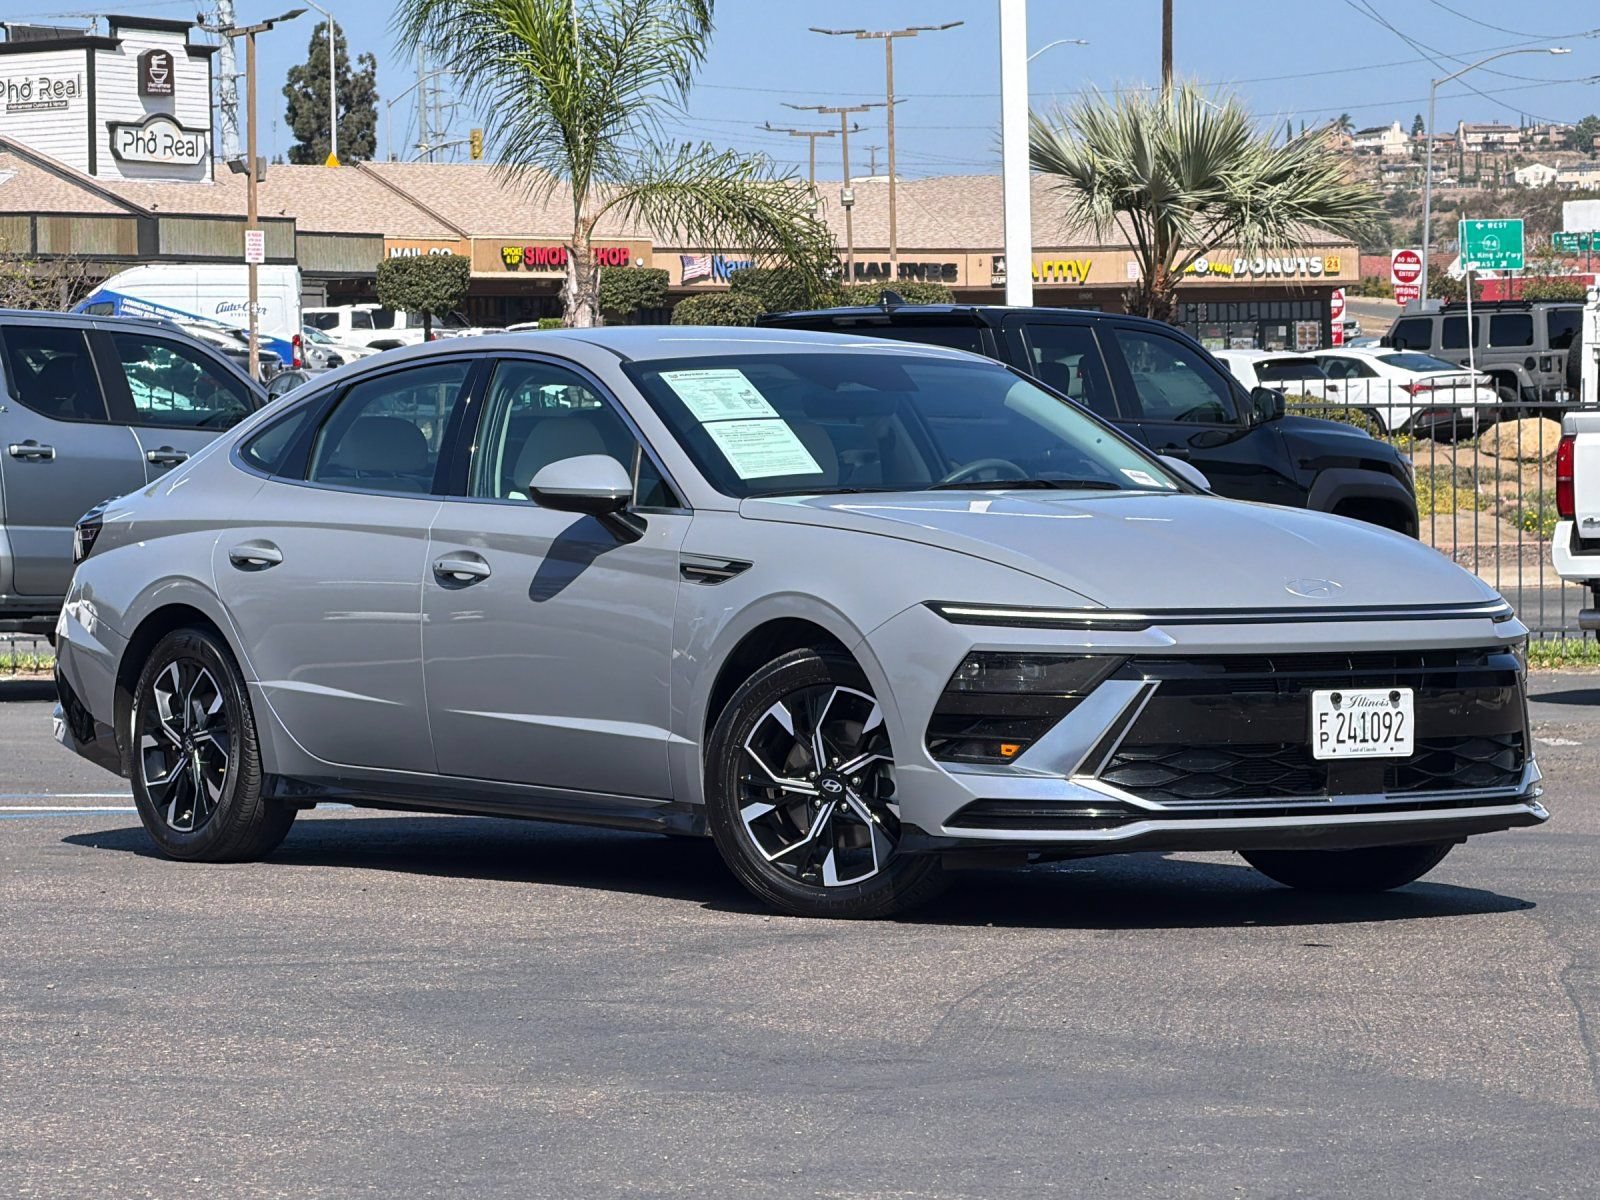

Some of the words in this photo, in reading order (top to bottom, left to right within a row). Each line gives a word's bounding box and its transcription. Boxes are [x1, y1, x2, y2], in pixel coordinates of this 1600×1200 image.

[39, 73, 81, 99] Real
[123, 130, 157, 154] Phở
[163, 133, 198, 157] Real
[502, 247, 523, 256] SMOKE
[511, 255, 520, 264] UP
[525, 246, 567, 265] SMOK
[594, 247, 630, 266] HOP
[1477, 252, 1493, 260] King
[1505, 251, 1521, 260] Fwy
[1032, 258, 1092, 282] rmy
[1234, 256, 1322, 274] DONUTS
[1326, 260, 1338, 268] 24
[1396, 287, 1418, 295] WRONG
[1345, 694, 1389, 709] Illinois
[1336, 711, 1405, 744] 241092
